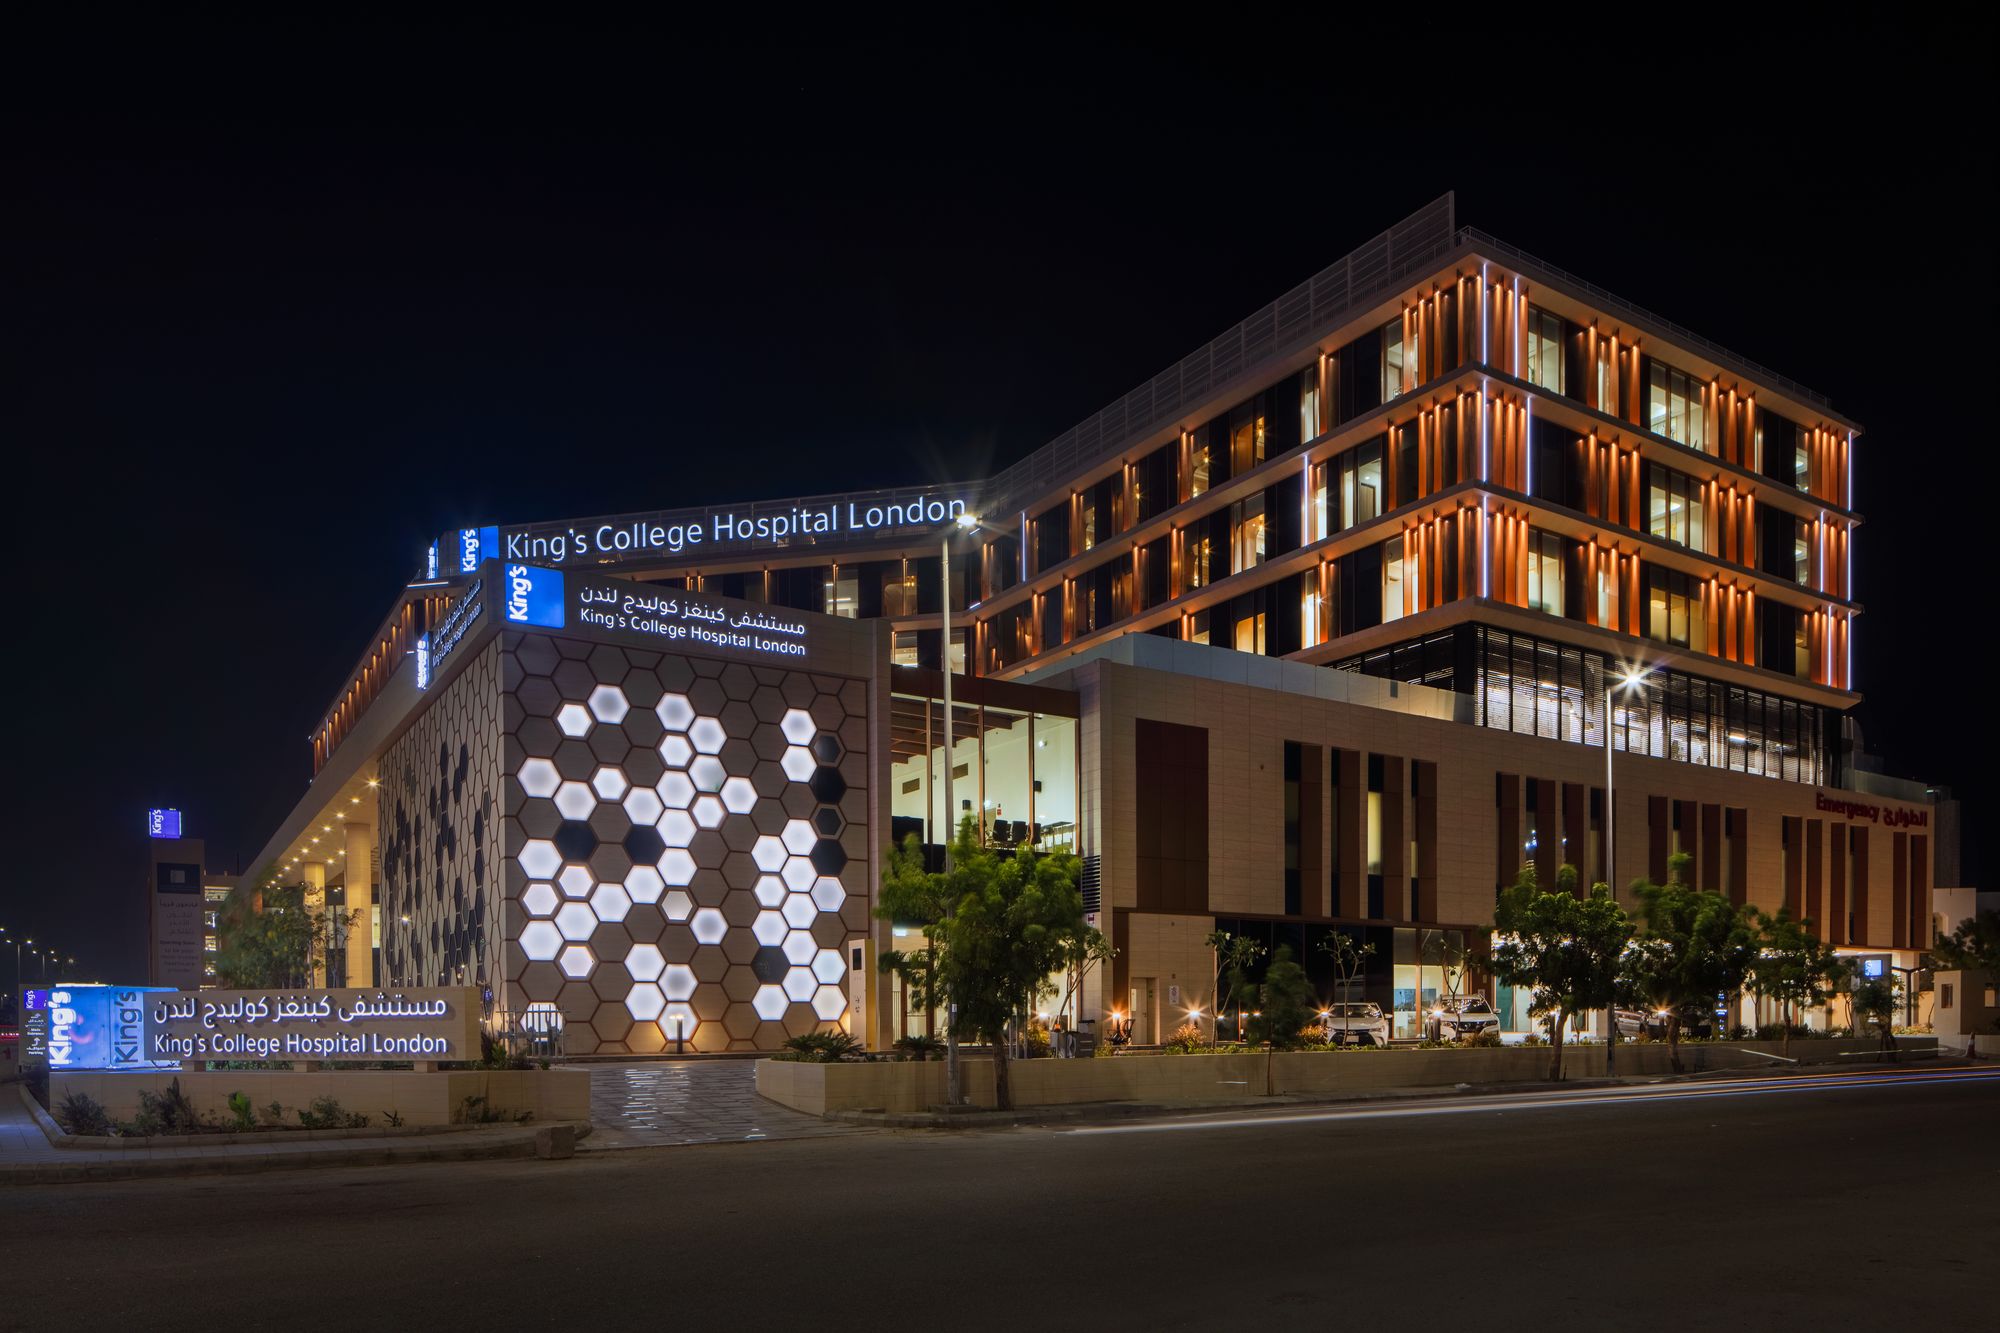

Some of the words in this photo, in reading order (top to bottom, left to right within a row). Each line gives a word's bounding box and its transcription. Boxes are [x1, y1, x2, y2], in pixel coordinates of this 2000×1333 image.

[507, 528, 588, 562] King's
[596, 522, 703, 552] College
[714, 506, 838, 543] Hospital
[849, 496, 966, 529] London
[462, 528, 479, 573] King's
[509, 565, 532, 621] King's
[580, 587, 617, 603] لندن
[623, 595, 678, 614] كوليدج
[681, 601, 725, 622] كينغز
[729, 613, 806, 635] مستشفى
[580, 608, 626, 629] King's
[630, 616, 687, 639] College
[691, 625, 751, 647] Hospital
[754, 636, 806, 656] London
[152, 809, 165, 834] King's
[1816, 792, 1880, 823] Emergency
[25, 990, 36, 1009] King's
[154, 997, 195, 1024] لندن
[203, 997, 268, 1029] كوليدج
[272, 995, 331, 1023] كينغز
[338, 991, 446, 1022] مستشفى
[48, 991, 77, 1065] King's
[113, 991, 143, 1063] King's
[154, 1033, 206, 1058] King's
[212, 1033, 281, 1058] College
[286, 1032, 366, 1057] Hospital
[373, 1033, 447, 1053] London
